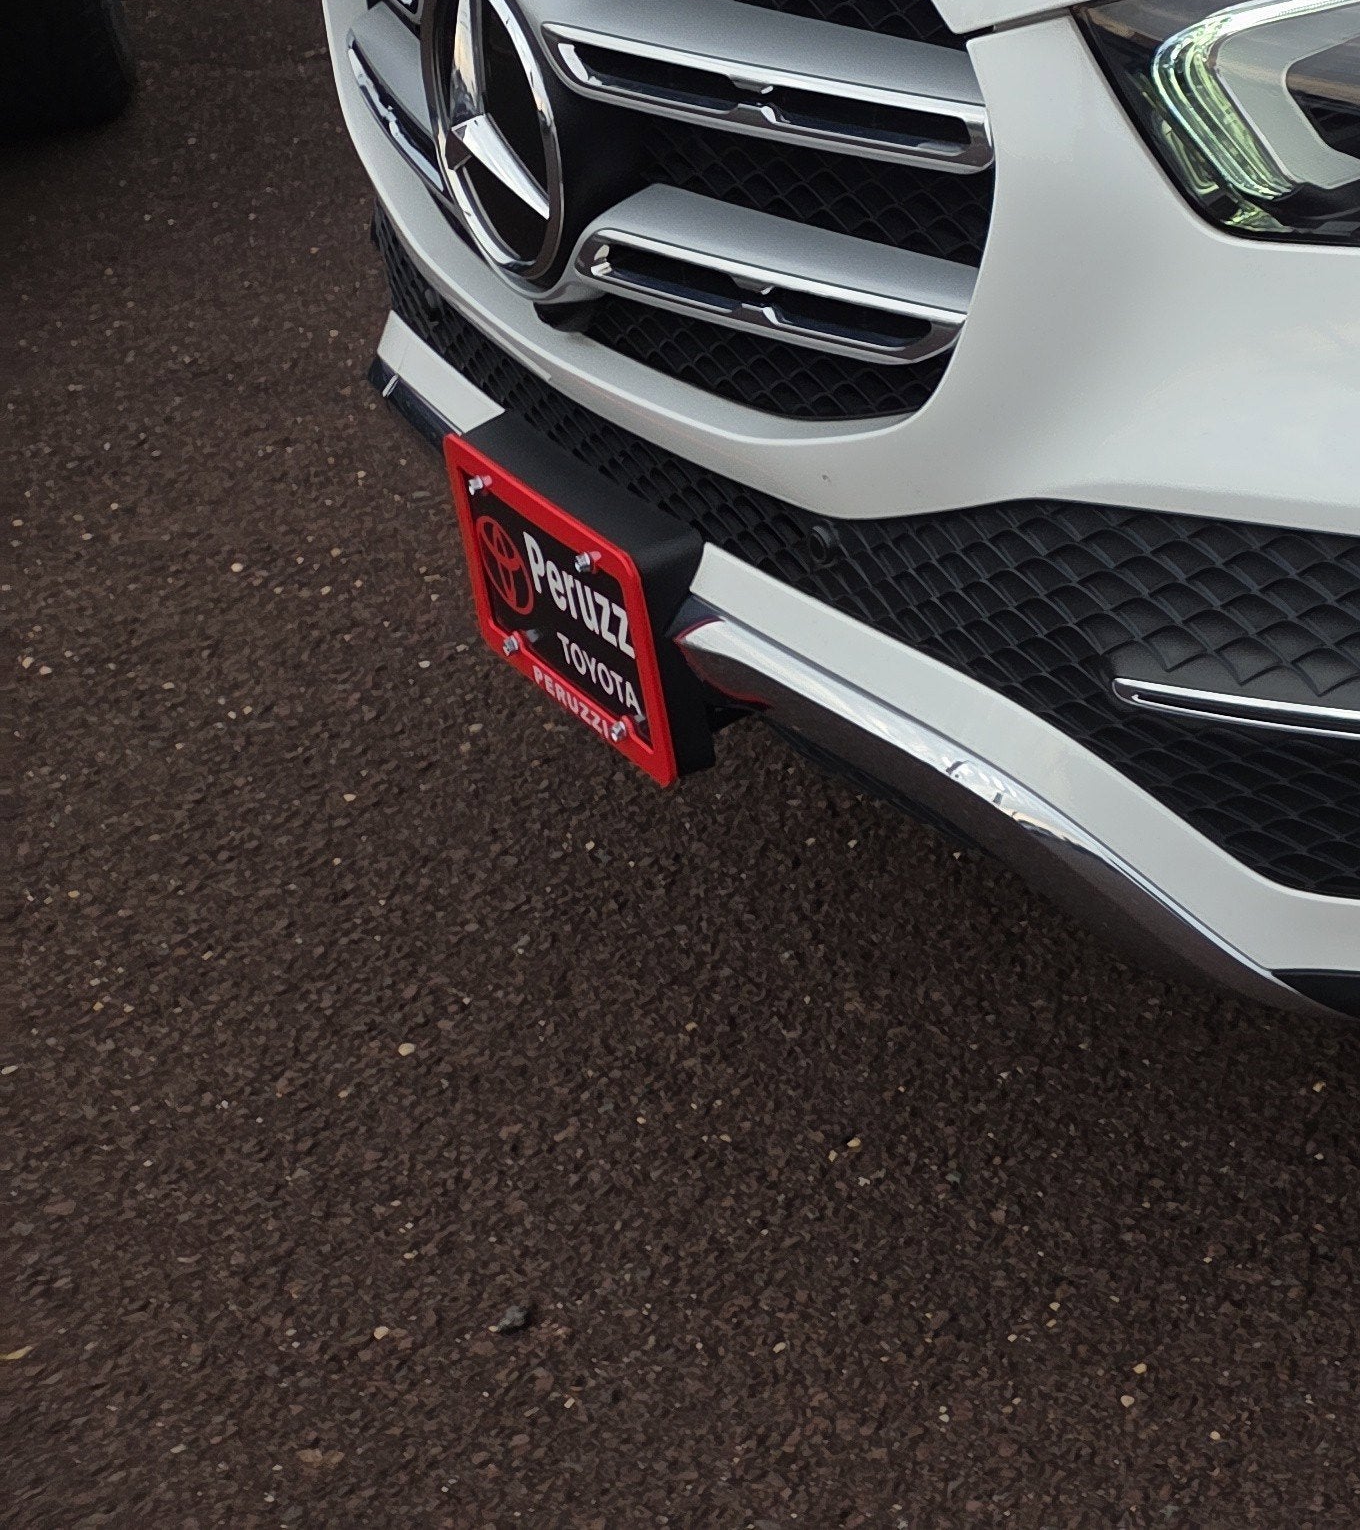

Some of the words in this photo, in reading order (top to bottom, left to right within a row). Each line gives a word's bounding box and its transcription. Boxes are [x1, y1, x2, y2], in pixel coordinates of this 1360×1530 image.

[522, 530, 636, 660] Peruzz
[532, 664, 610, 740] PERUZZI
[556, 631, 644, 716] TOYOTA
